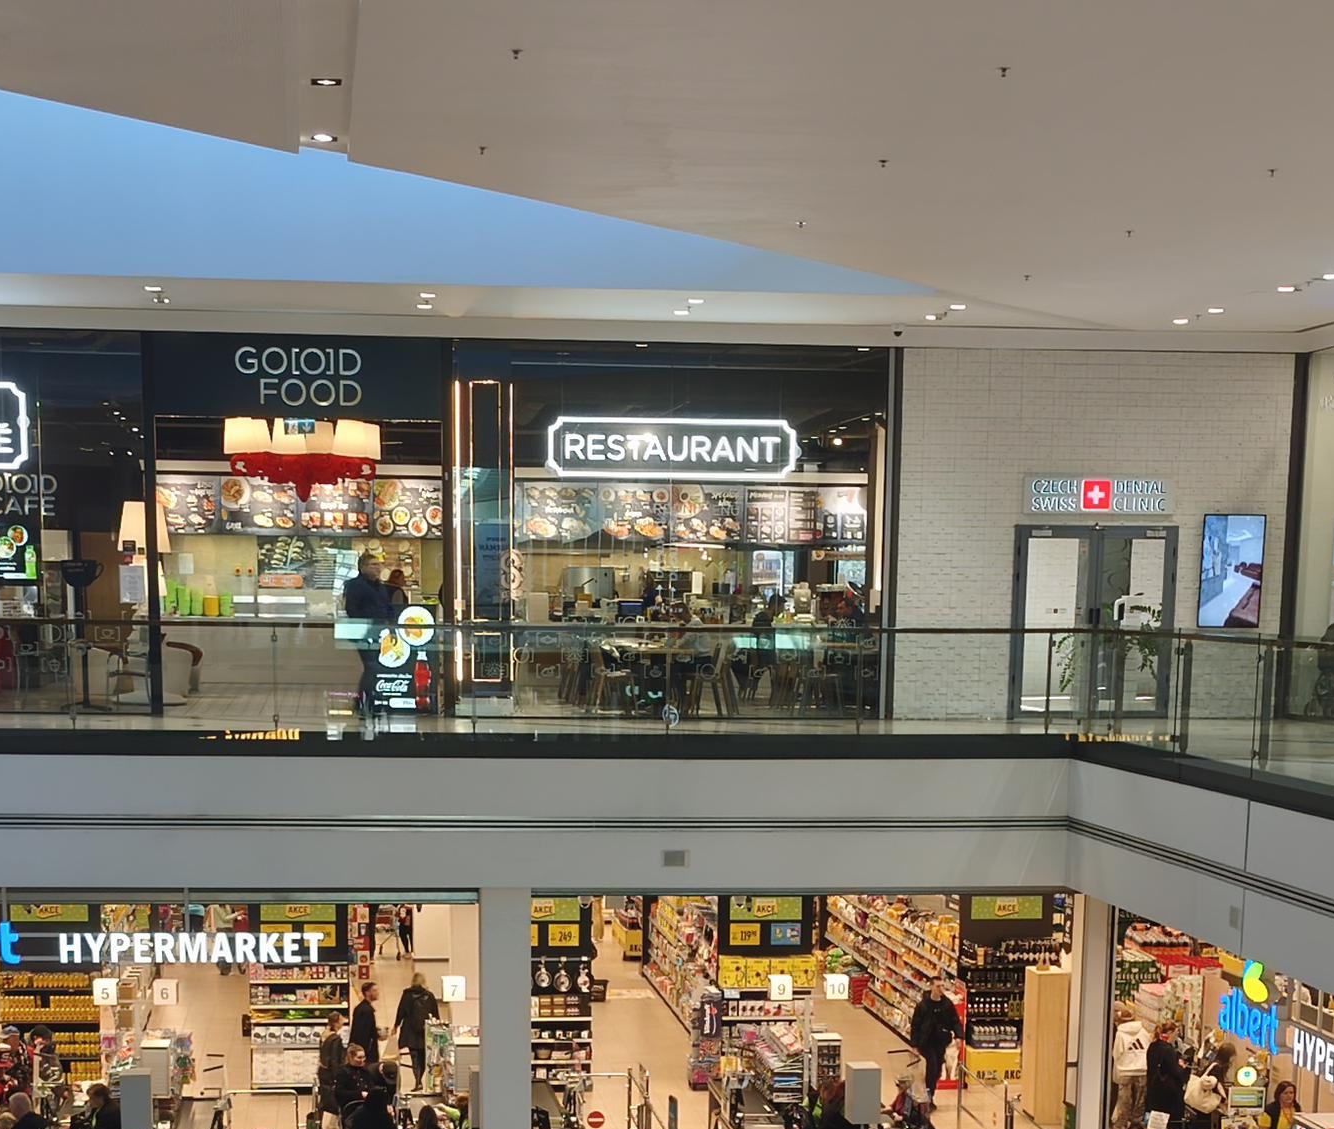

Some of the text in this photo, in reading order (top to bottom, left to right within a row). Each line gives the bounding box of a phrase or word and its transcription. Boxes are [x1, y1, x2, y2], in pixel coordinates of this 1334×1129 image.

[259, 379, 362, 407] FOOD
[564, 433, 782, 465] RESTAURANT
[1031, 479, 1166, 494] CZECH DENTAL
[1031, 497, 1165, 512] SWISS CLINIC
[288, 905, 308, 915] AKCE
[756, 904, 775, 914] AKCE
[997, 903, 1018, 913] AKCE
[58, 931, 325, 964] HYPERMARKET
[101, 987, 110, 1001] 5
[161, 987, 170, 1001] 6
[449, 984, 458, 998] 7
[777, 982, 786, 997] 9
[829, 981, 846, 995] 10
[1219, 986, 1279, 1057] albert
[1003, 1070, 1021, 1080] AKC
